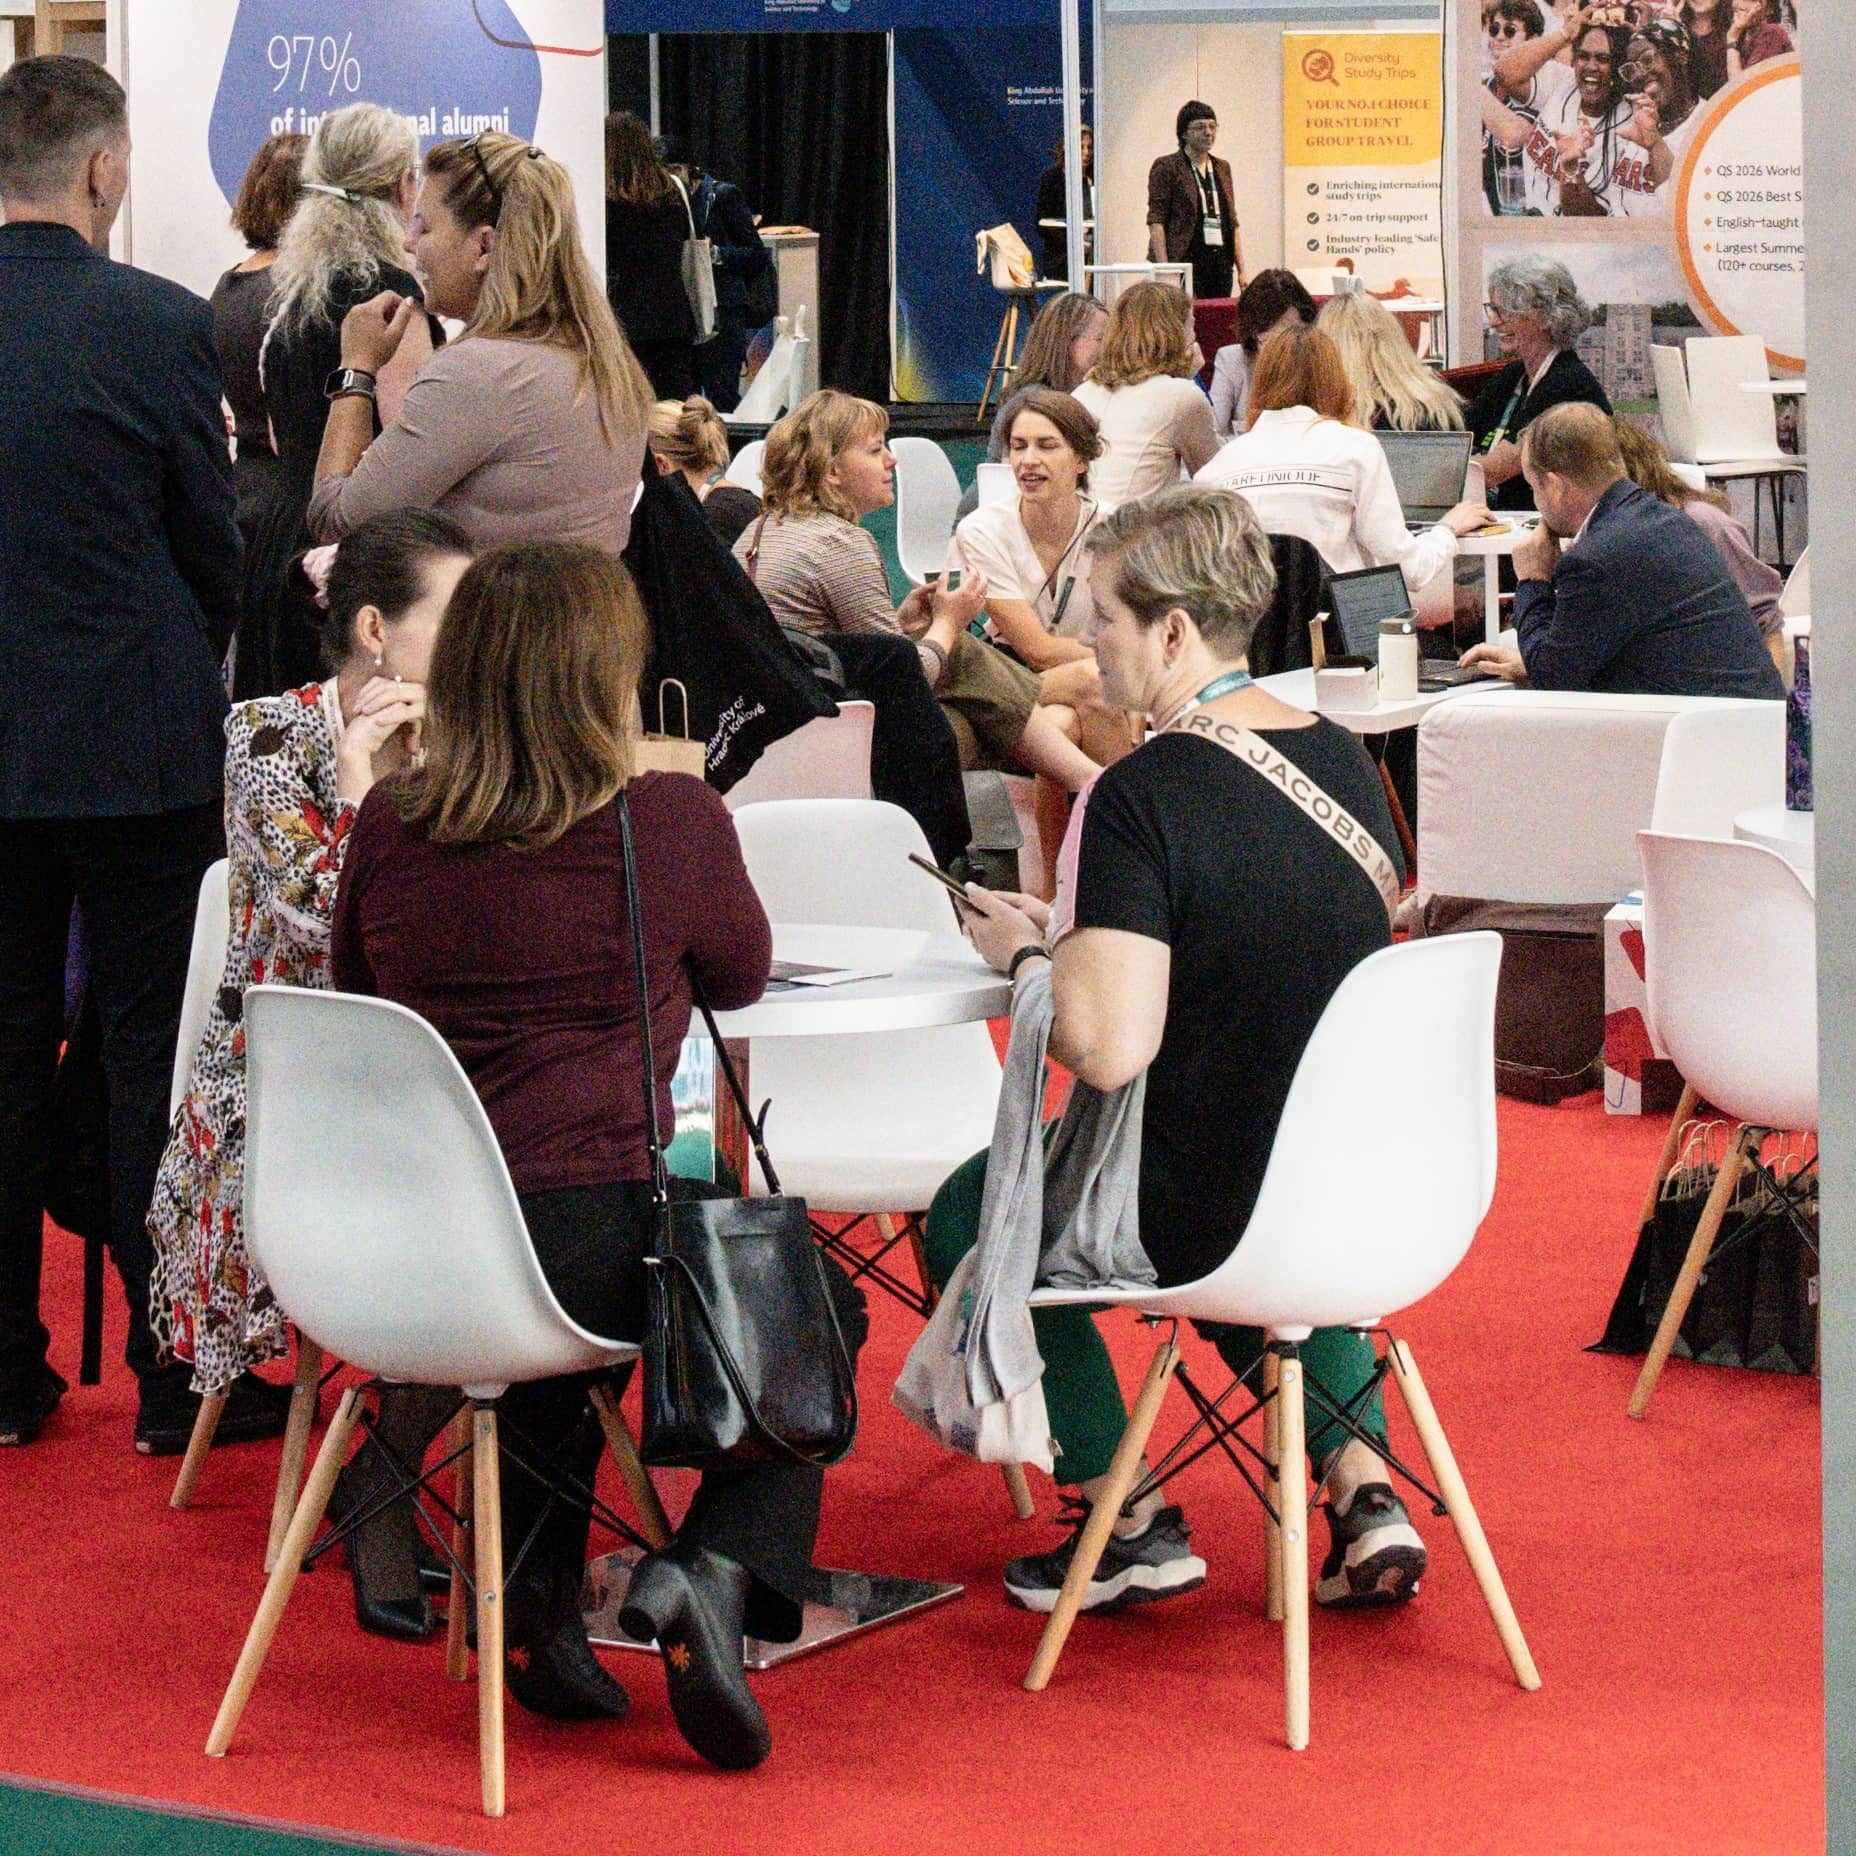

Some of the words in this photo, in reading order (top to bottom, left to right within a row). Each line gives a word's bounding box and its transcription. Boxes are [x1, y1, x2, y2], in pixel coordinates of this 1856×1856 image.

[267, 31, 361, 97] 97%
[1344, 52, 1400, 65] Diversity
[1344, 66, 1383, 80] Study
[1386, 66, 1417, 80] Trips
[1306, 99, 1345, 110] YOUR
[1378, 98, 1432, 110] CHOICE
[270, 106, 295, 136] of
[441, 106, 510, 136] alumni
[1305, 117, 1334, 129] FOR
[1336, 116, 1402, 129] STUDENT
[1305, 135, 1355, 147] GROUP
[1358, 135, 1414, 147] TRAVEL
[1716, 165, 1733, 178] QS
[1735, 165, 1763, 176] 2026
[1765, 164, 1801, 176] World
[1326, 180, 1377, 191] Enriching
[1326, 192, 1355, 202] study
[1356, 192, 1382, 202] trips
[1716, 190, 1733, 204] QS
[1735, 190, 1764, 202] 2026
[1766, 190, 1791, 202] Best
[1326, 212, 1348, 222] 24/7
[1387, 212, 1429, 224] support
[1716, 216, 1799, 230] English-taught
[1364, 244, 1396, 256] policy
[1716, 242, 1758, 256] Largest
[1717, 259, 1746, 272] (120+
[1248, 747, 1373, 861] JACOBS
